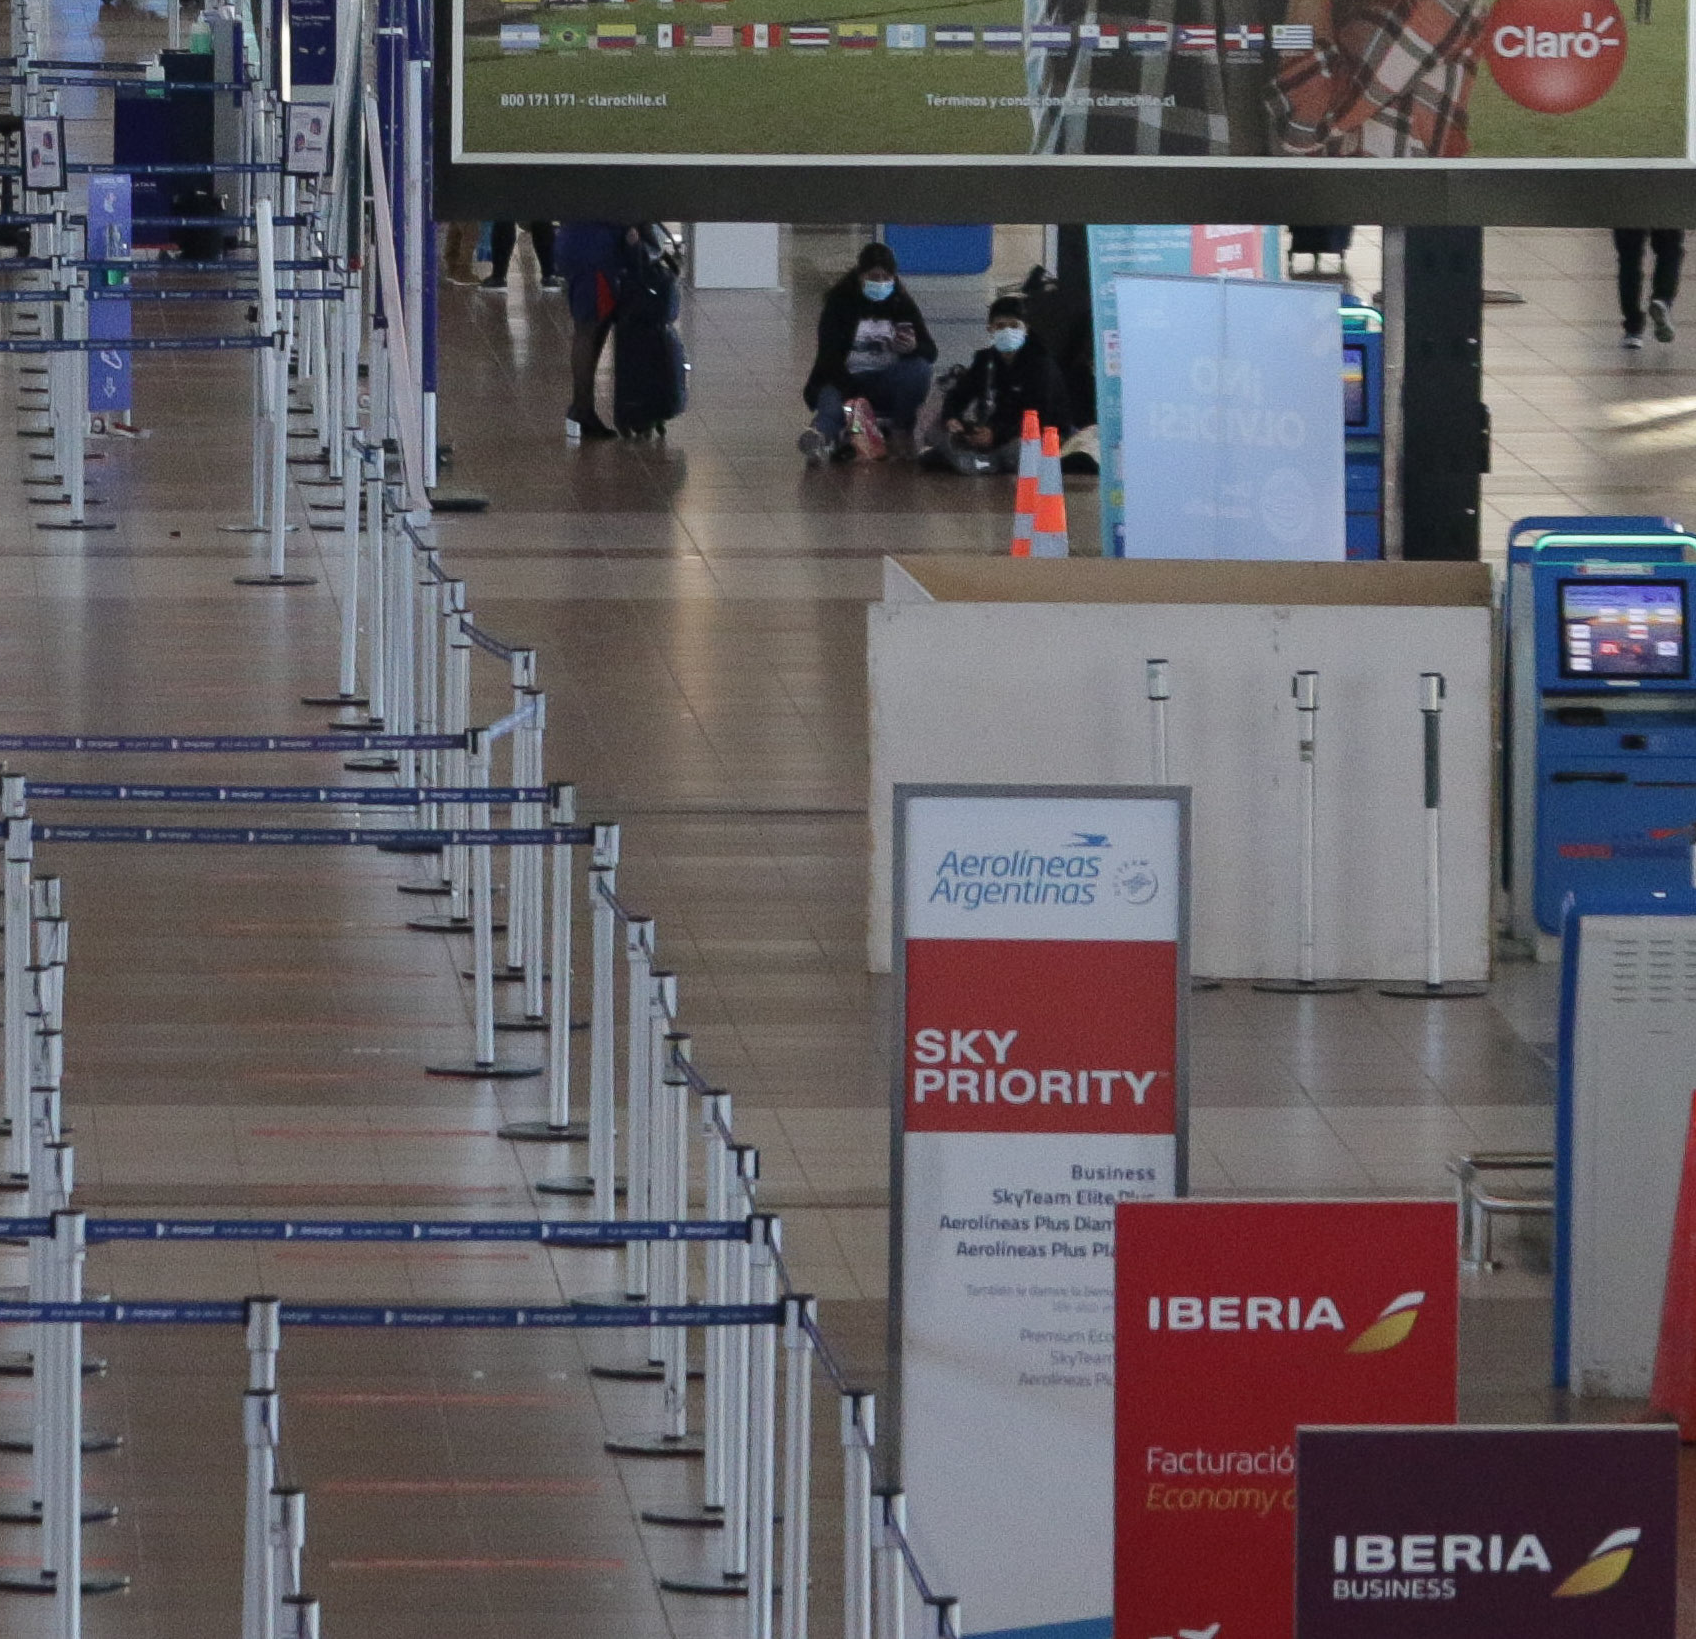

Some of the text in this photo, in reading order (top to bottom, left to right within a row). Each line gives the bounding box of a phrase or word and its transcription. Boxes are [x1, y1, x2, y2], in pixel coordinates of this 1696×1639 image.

[1492, 24, 1602, 62] Claro
[500, 93, 524, 107] 800
[528, 93, 549, 107] 171
[554, 93, 576, 107] 171
[587, 92, 668, 108] clarochile.cl
[925, 93, 988, 107] Términos
[989, 97, 998, 109] y
[936, 849, 1102, 878] Aerolíneas
[928, 879, 1097, 910] Argentinas
[914, 1028, 1019, 1064] SKY
[913, 1068, 1158, 1105] PRIORITY
[1071, 1165, 1157, 1182] Business
[992, 1188, 1072, 1208] SkyTeam
[1076, 1188, 1115, 1206] Elite
[939, 1214, 1030, 1232] Aerolíneas
[1034, 1214, 1071, 1232] Plus
[956, 1241, 1047, 1259] Aerolíneas
[1051, 1241, 1087, 1259] Plus
[1147, 1295, 1345, 1332] IBERIA
[1145, 1444, 1295, 1476] Facturació
[1145, 1483, 1279, 1518] Economy
[1332, 1533, 1553, 1574] IBERIA
[1331, 1577, 1458, 1601] BUSINESS
